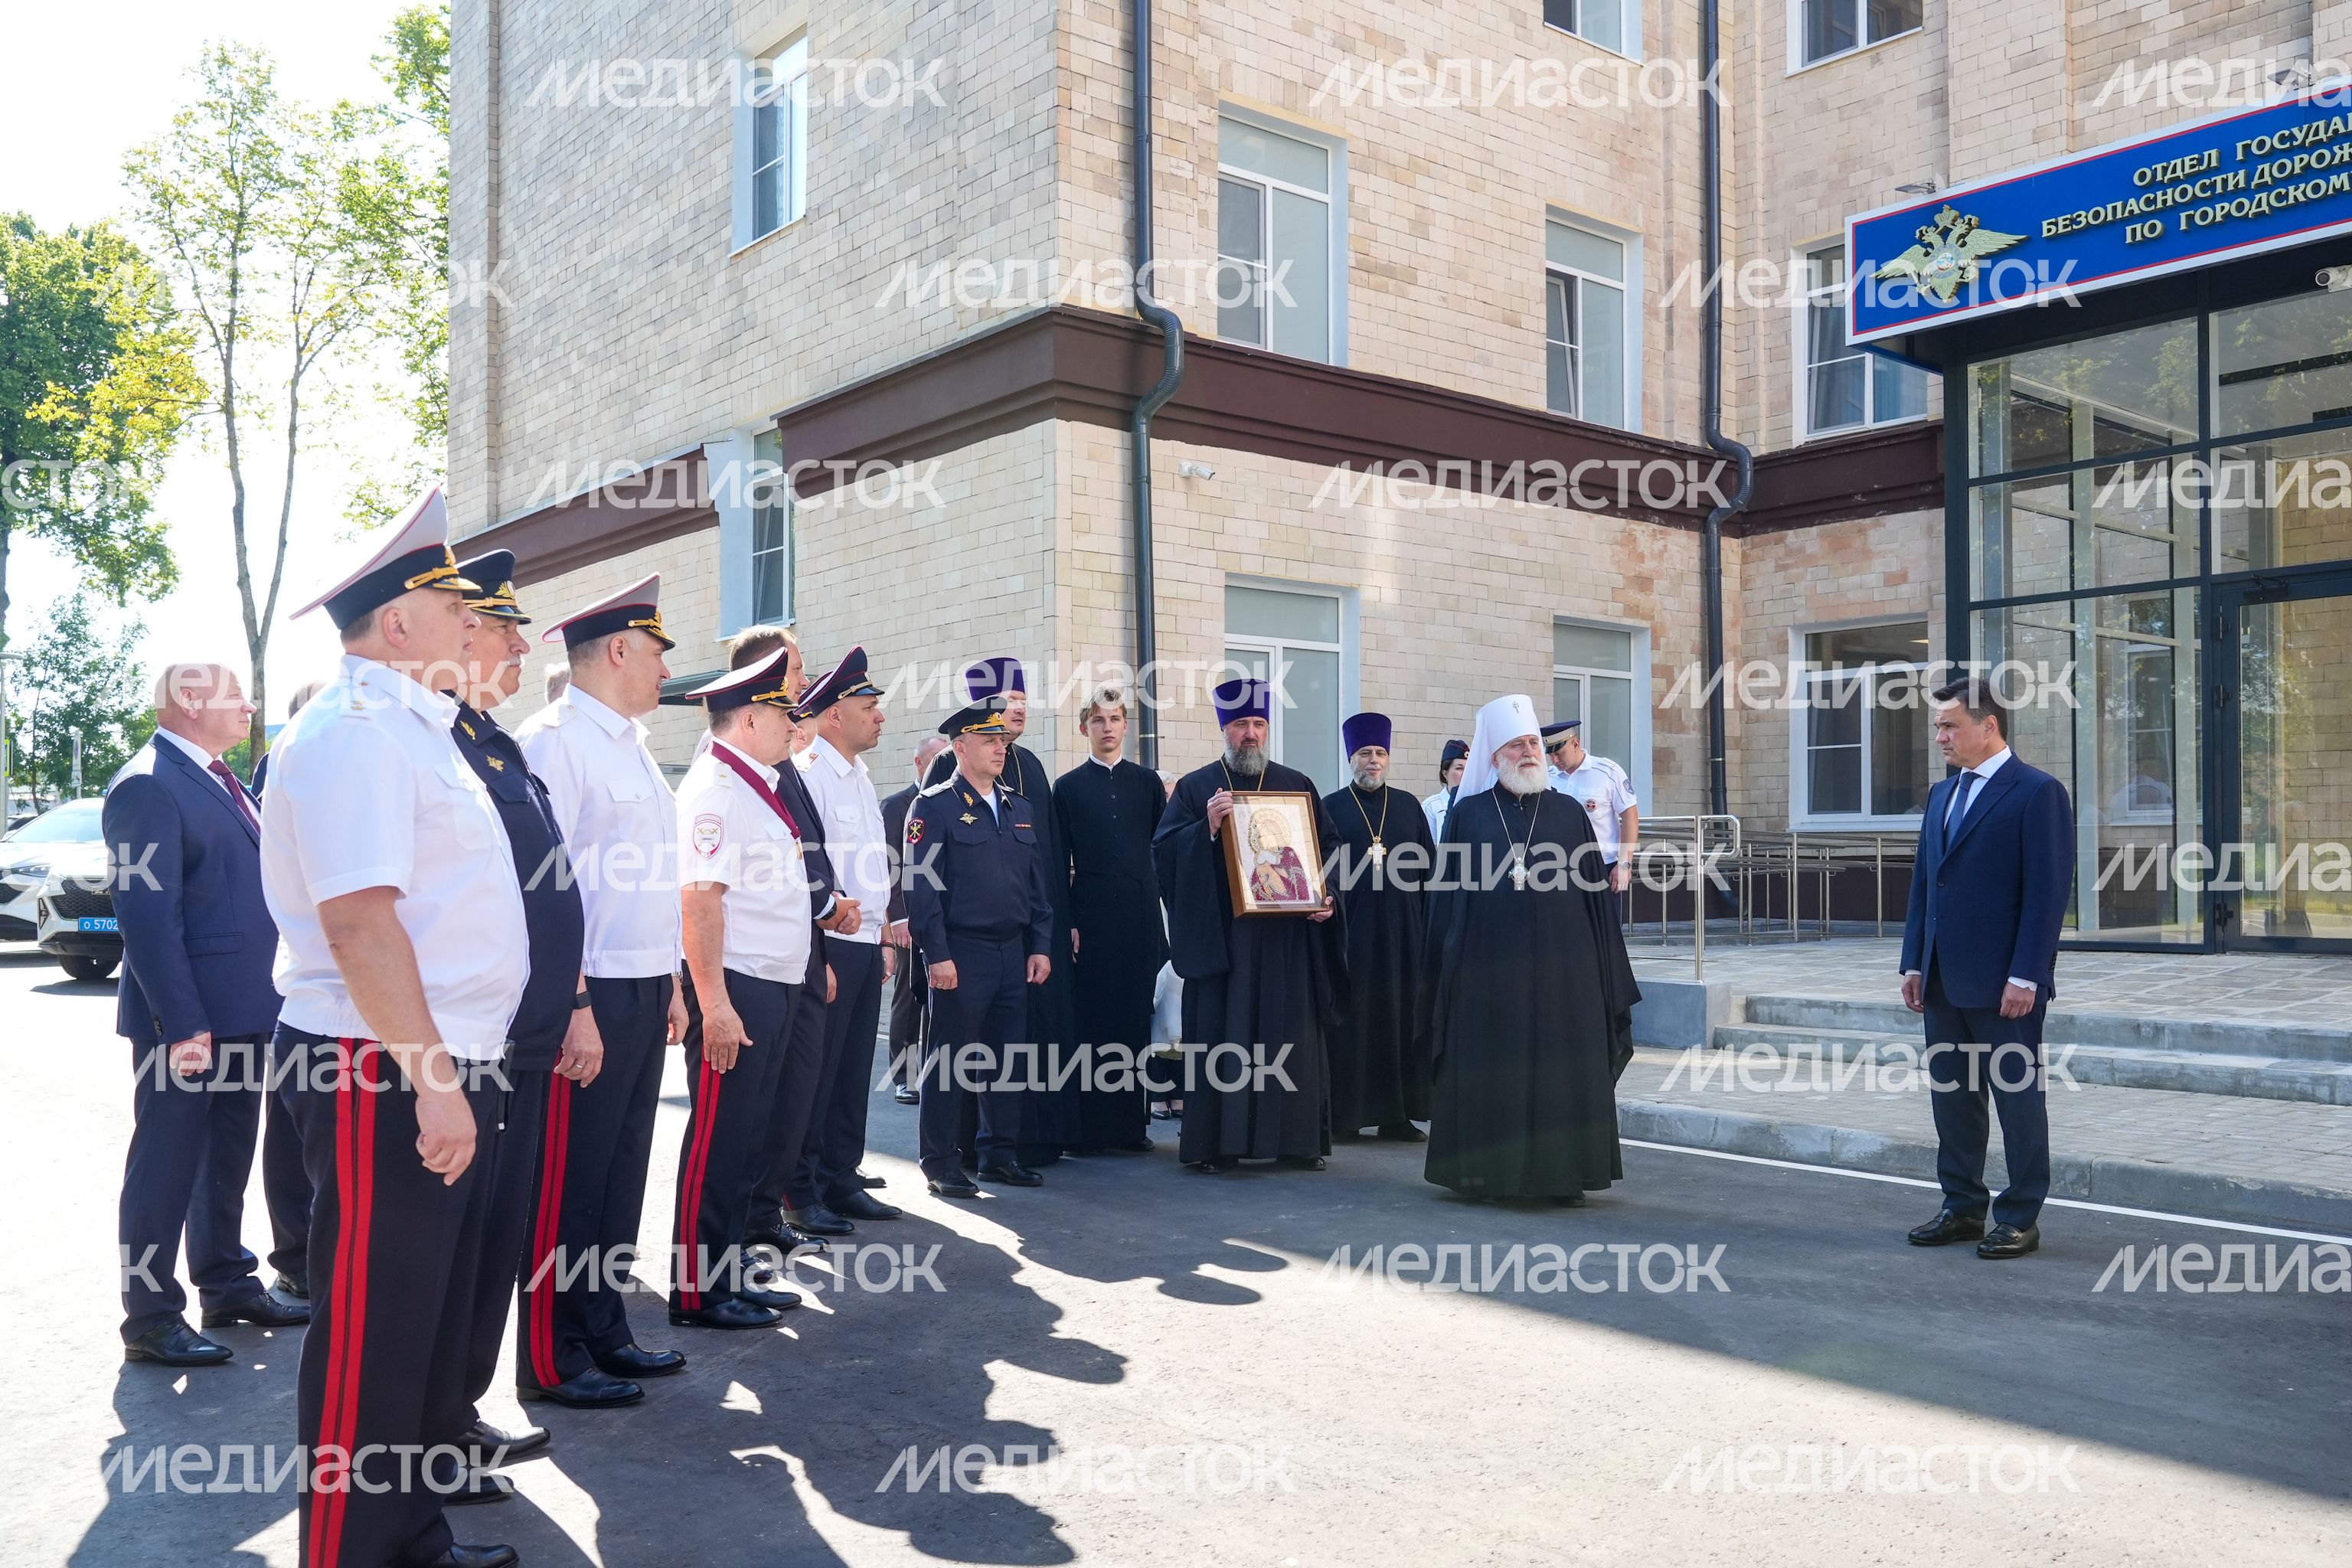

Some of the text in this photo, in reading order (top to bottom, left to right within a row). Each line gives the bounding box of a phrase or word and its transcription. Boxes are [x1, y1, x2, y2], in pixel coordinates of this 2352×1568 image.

[2041, 142, 2352, 238] БЕЗОПАСНОСТИ ДОРОЖ
[2133, 149, 2220, 187] ОТДЕЛ
[2125, 171, 2352, 244] ПО ГОРОДСКОМ
